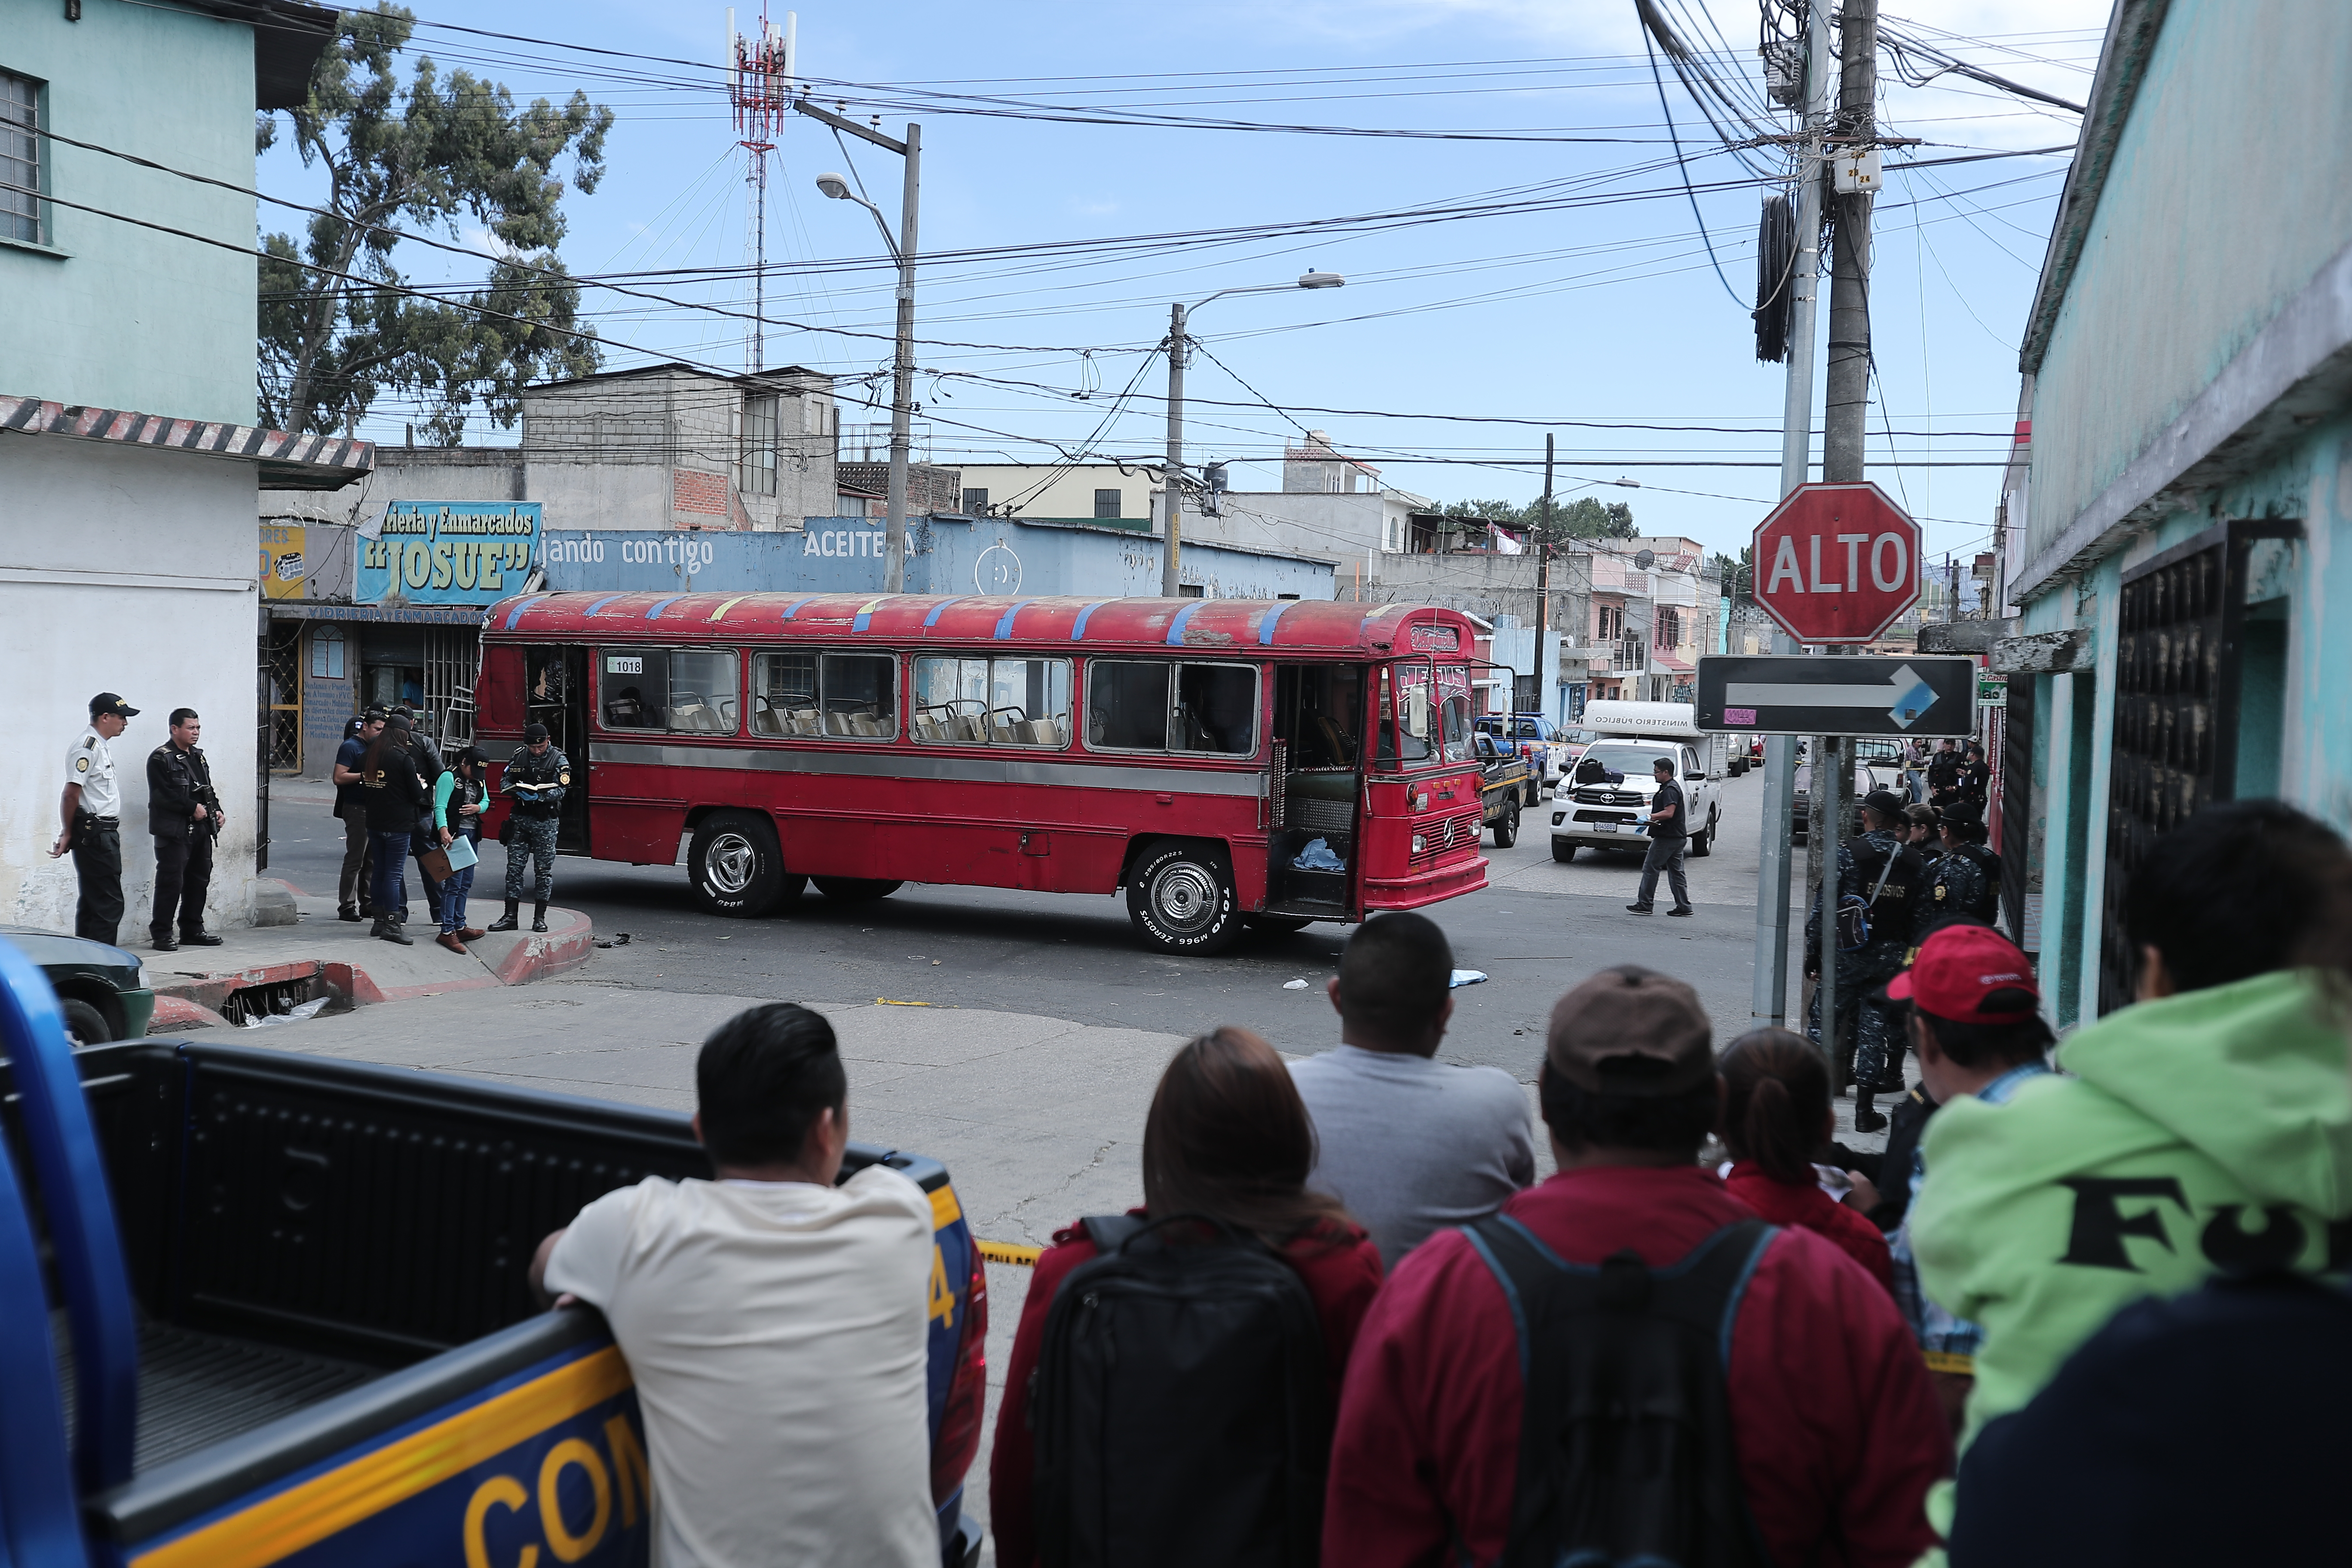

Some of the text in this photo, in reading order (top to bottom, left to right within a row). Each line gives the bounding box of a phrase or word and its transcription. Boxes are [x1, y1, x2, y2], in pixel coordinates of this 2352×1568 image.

[382, 506, 426, 534] rieria
[439, 507, 533, 535] Enmarcados
[622, 533, 713, 575] contigo
[802, 530, 918, 557] ACEITEA
[1767, 532, 1908, 594] ALTO
[308, 607, 383, 621] VIDRIERIA
[617, 662, 640, 672] 1018
[1400, 666, 1466, 688] JESUS
[1140, 910, 1174, 943] ZEROSYS
[1179, 933, 1208, 945] M966
